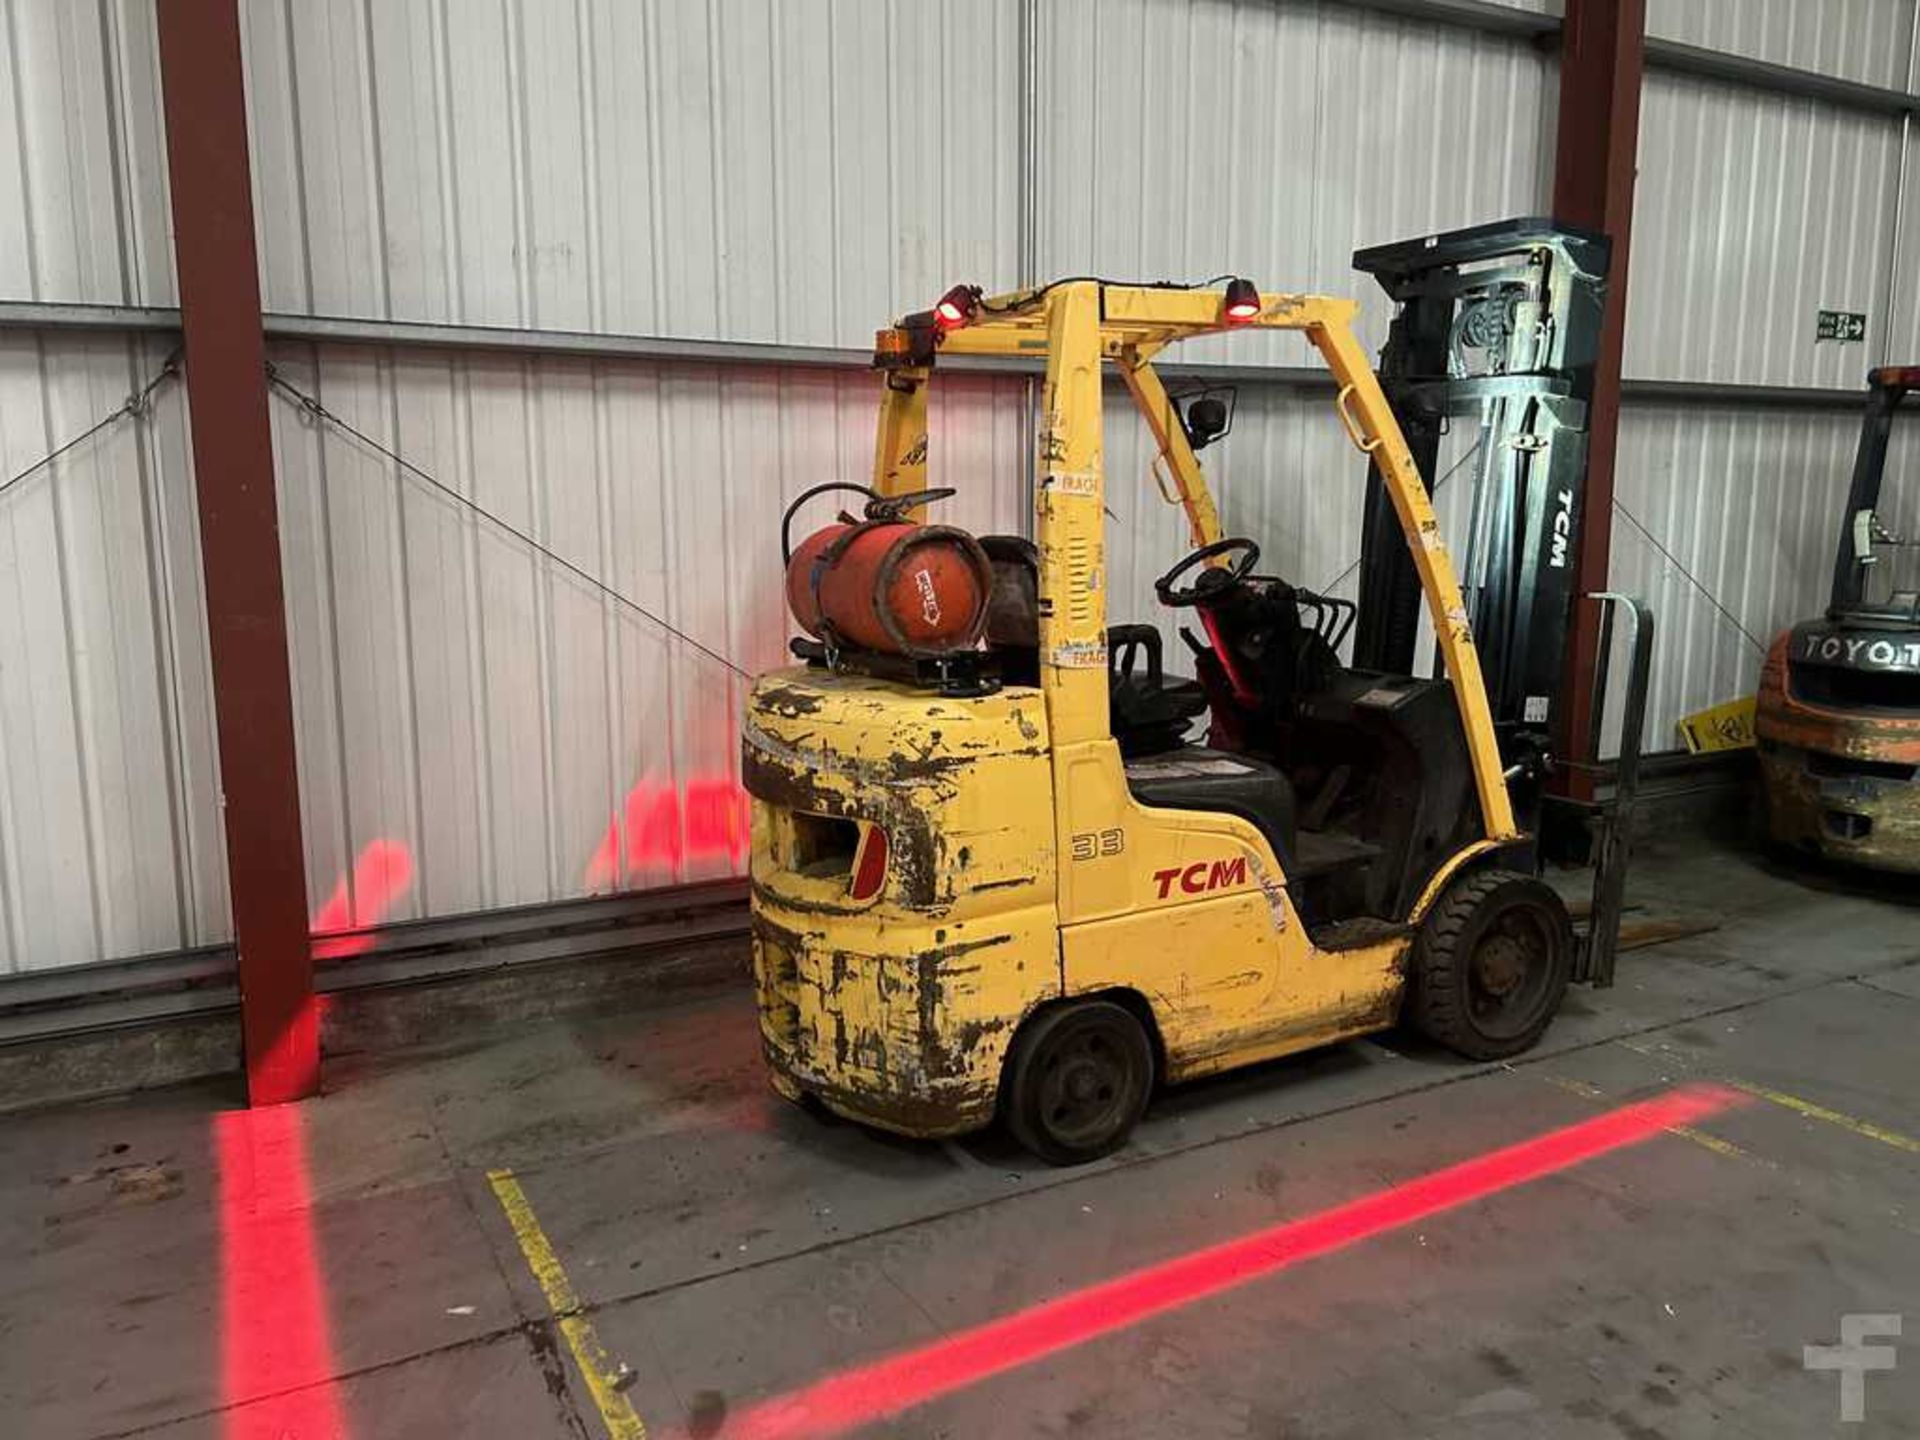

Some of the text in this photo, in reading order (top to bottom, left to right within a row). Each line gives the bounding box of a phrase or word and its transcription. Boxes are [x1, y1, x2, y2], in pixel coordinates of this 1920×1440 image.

[1549, 489, 1573, 568] TCM
[1071, 828, 1125, 862] 33
[1152, 857, 1247, 900] TCM
